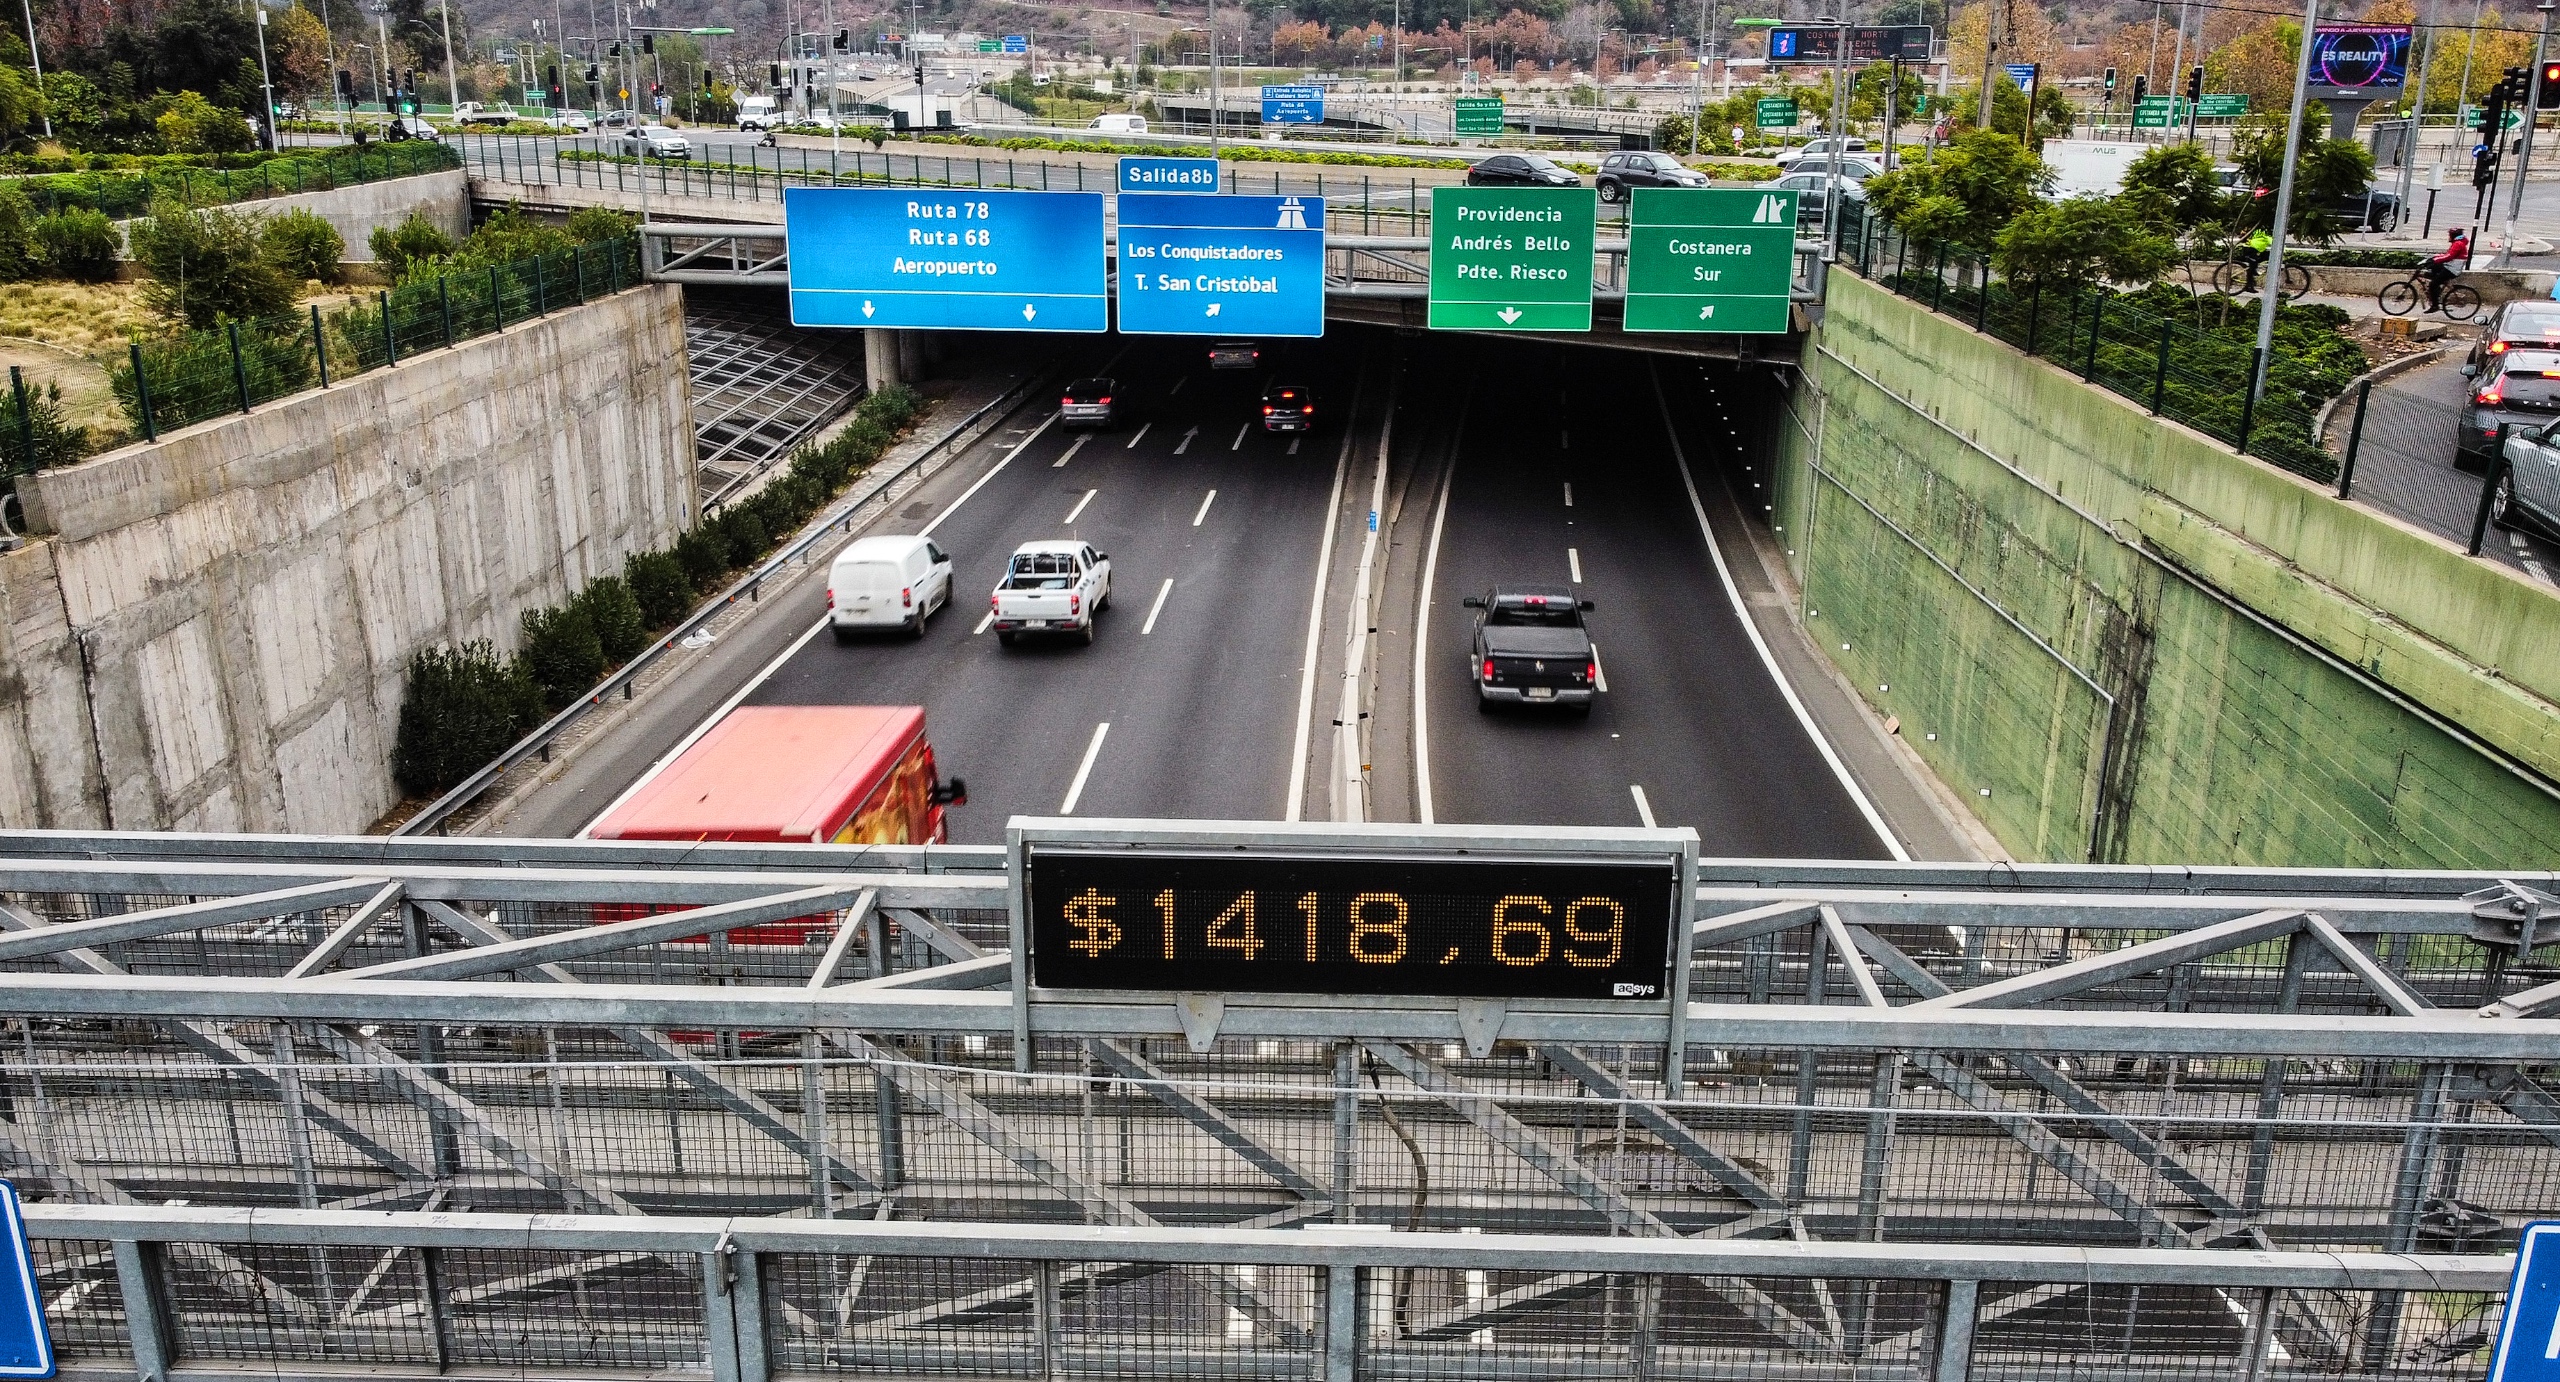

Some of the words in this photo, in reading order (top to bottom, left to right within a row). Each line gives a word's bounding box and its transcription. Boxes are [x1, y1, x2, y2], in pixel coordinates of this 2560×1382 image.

[2323, 51, 2337, 60] ES
[2338, 51, 2386, 62] REALITY
[907, 201, 958, 219] Ruta
[964, 202, 990, 219] 78
[1458, 206, 1563, 222] Providencia
[909, 228, 959, 246] Ruta
[965, 229, 991, 247] 68
[1451, 234, 1513, 251] Andrés
[1525, 236, 1571, 252] Bello
[1128, 243, 1156, 259] Los
[1161, 243, 1284, 263] Conquistadores
[1669, 239, 1753, 256] Costanera
[893, 257, 998, 278] Aeropuerto
[1458, 264, 1504, 280] Pdte.
[1511, 264, 1569, 281] Riesco
[1693, 266, 1722, 282] Sur
[1135, 273, 1149, 291] T.
[1158, 274, 1192, 292] San
[1196, 275, 1279, 294] Cristóbal
[1616, 984, 1655, 996] aesys
